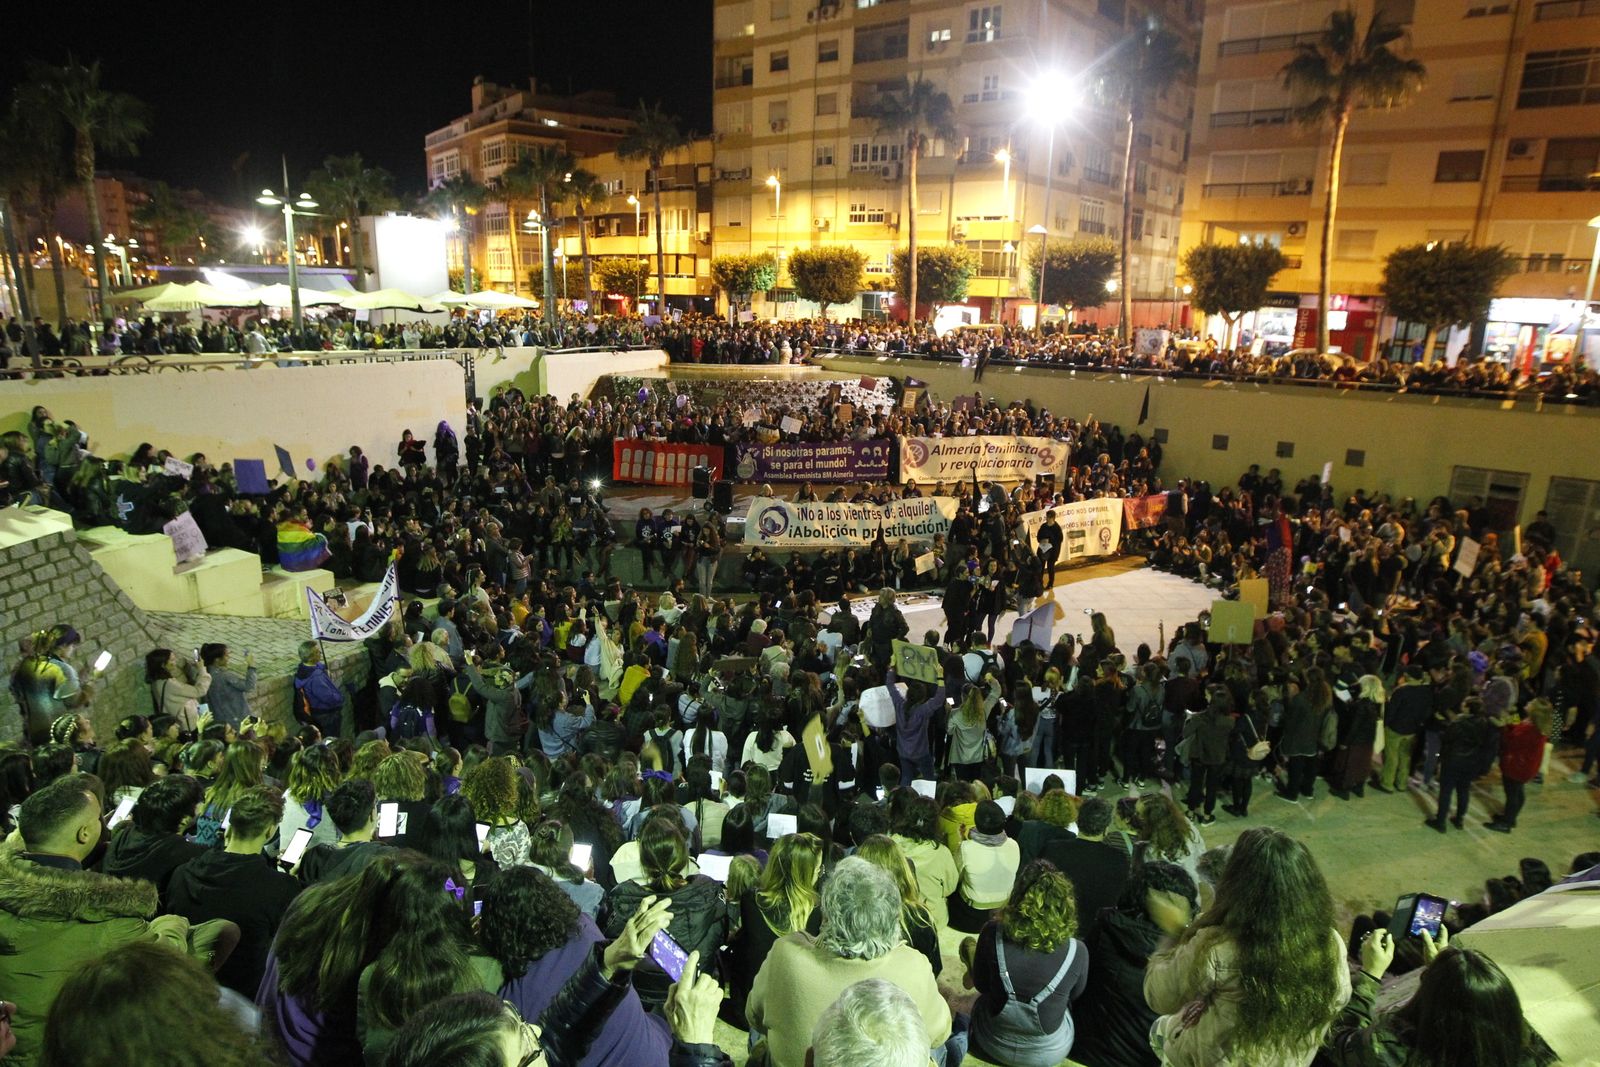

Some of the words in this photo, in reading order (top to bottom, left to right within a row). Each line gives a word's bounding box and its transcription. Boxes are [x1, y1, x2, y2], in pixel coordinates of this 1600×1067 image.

[776, 447, 813, 458] nosotras
[816, 446, 855, 459] paramos,
[931, 443, 981, 456] Almería
[982, 442, 1038, 456] feminista
[1038, 447, 1056, 466] 8
[771, 462, 781, 470] se
[783, 461, 803, 472] para
[805, 459, 813, 469] el
[816, 457, 847, 469] mundo!
[940, 462, 947, 473] y
[950, 457, 1034, 470] revolucionaria
[764, 471, 792, 480] Asamblea
[793, 471, 821, 479] Feminista
[822, 471, 832, 479] 8M
[833, 470, 854, 479] Almería
[818, 510, 824, 521] a
[826, 507, 841, 521] los
[844, 506, 882, 521] vientres
[898, 500, 937, 520] alquiler!
[789, 524, 857, 539] ¡Abolición
[863, 518, 949, 541] prstitución!
